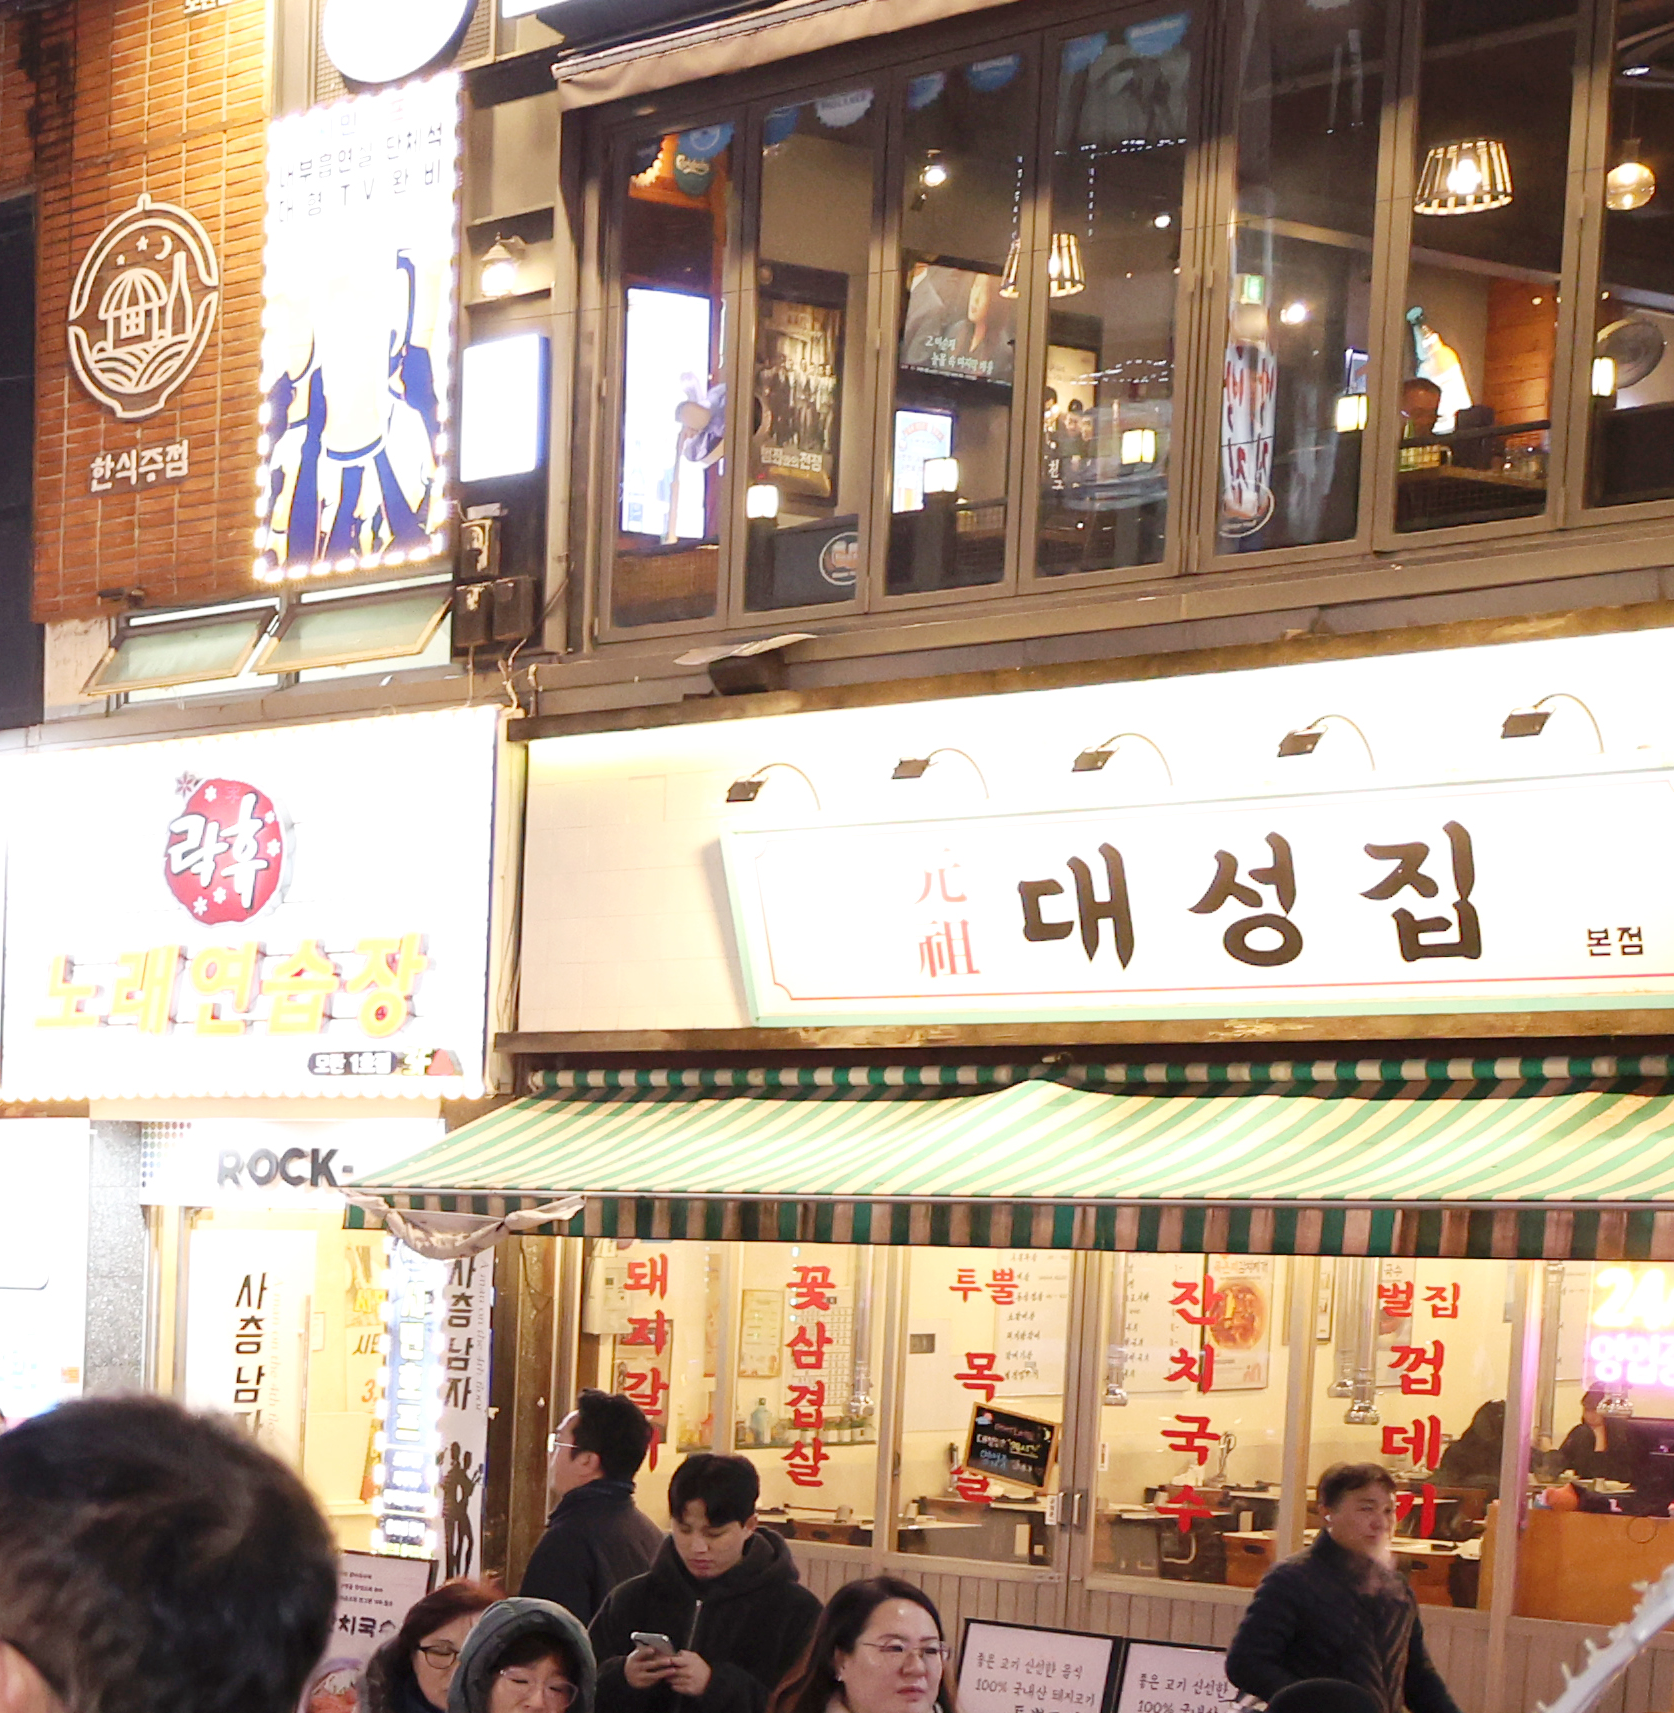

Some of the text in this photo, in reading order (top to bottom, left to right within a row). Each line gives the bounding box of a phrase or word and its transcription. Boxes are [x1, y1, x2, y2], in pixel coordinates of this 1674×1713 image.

[1017, 820, 1483, 971] 대성집
[1584, 926, 1645, 958] 본점
[34, 932, 432, 1039] 노래연습장
[443, 1255, 477, 1412] 사층남자
[1592, 1266, 1674, 1331] 24
[782, 1265, 838, 1488] 꽃삼겹살
[1155, 1273, 1224, 1534] 잔치국수
[975, 1677, 1008, 1694] 100%
[1012, 1683, 1048, 1700] 국내산
